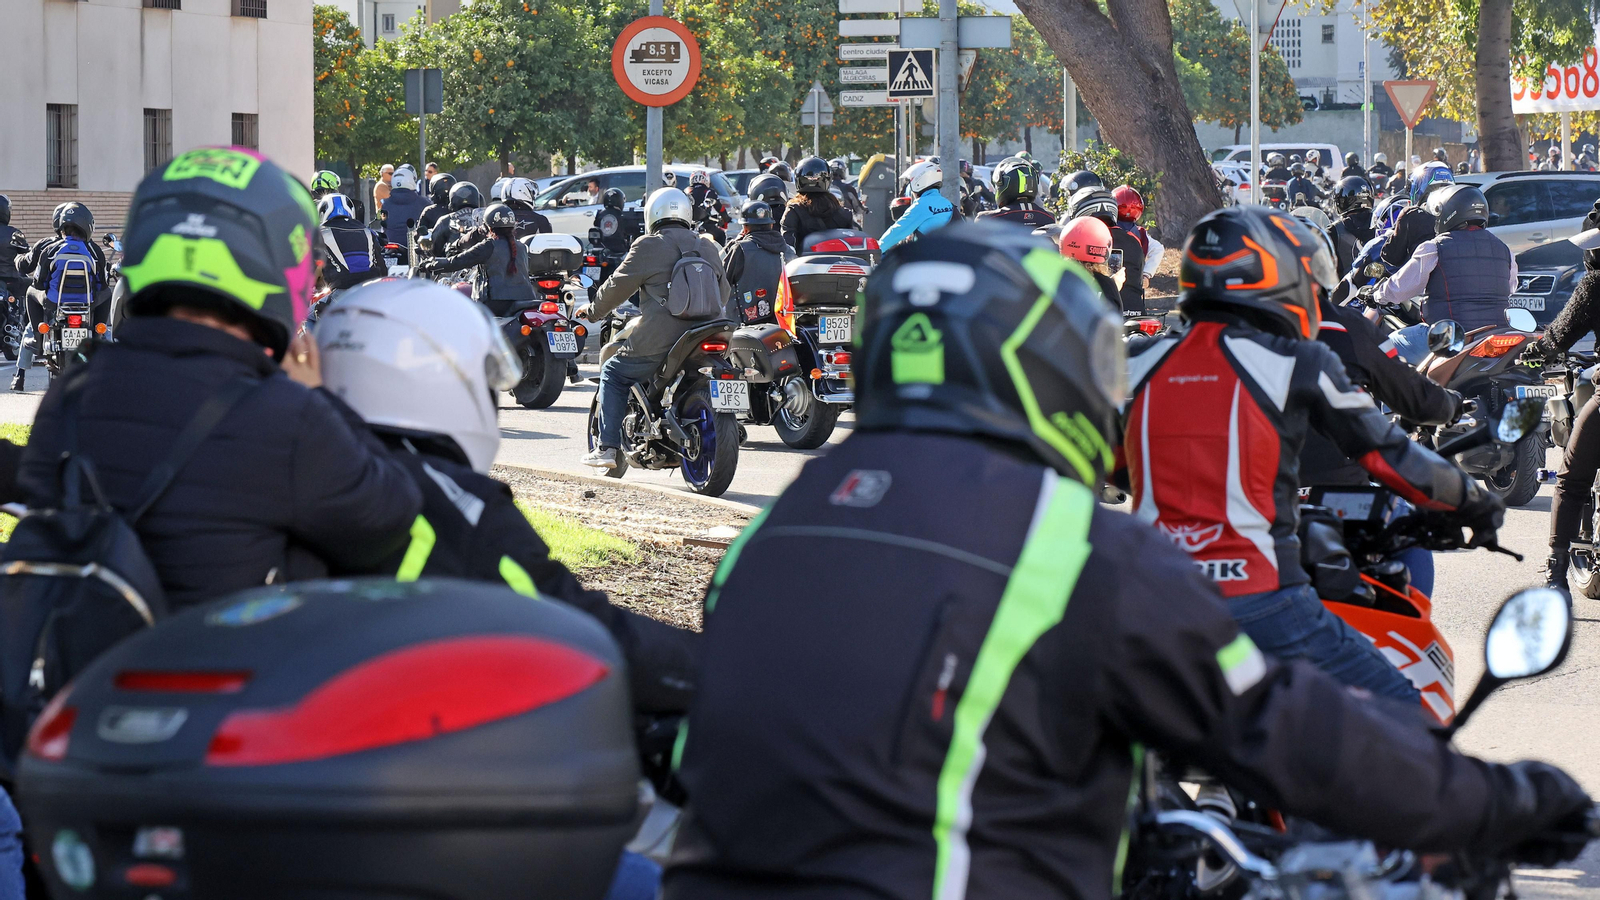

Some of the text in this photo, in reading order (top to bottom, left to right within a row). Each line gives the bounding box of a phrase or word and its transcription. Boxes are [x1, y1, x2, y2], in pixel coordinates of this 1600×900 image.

[648, 44, 675, 56] 8,5 t
[826, 318, 848, 328] 9529
[826, 330, 845, 340] CVD
[556, 343, 576, 351] 0973
[720, 382, 746, 394] 2822
[720, 394, 740, 406] JFS
